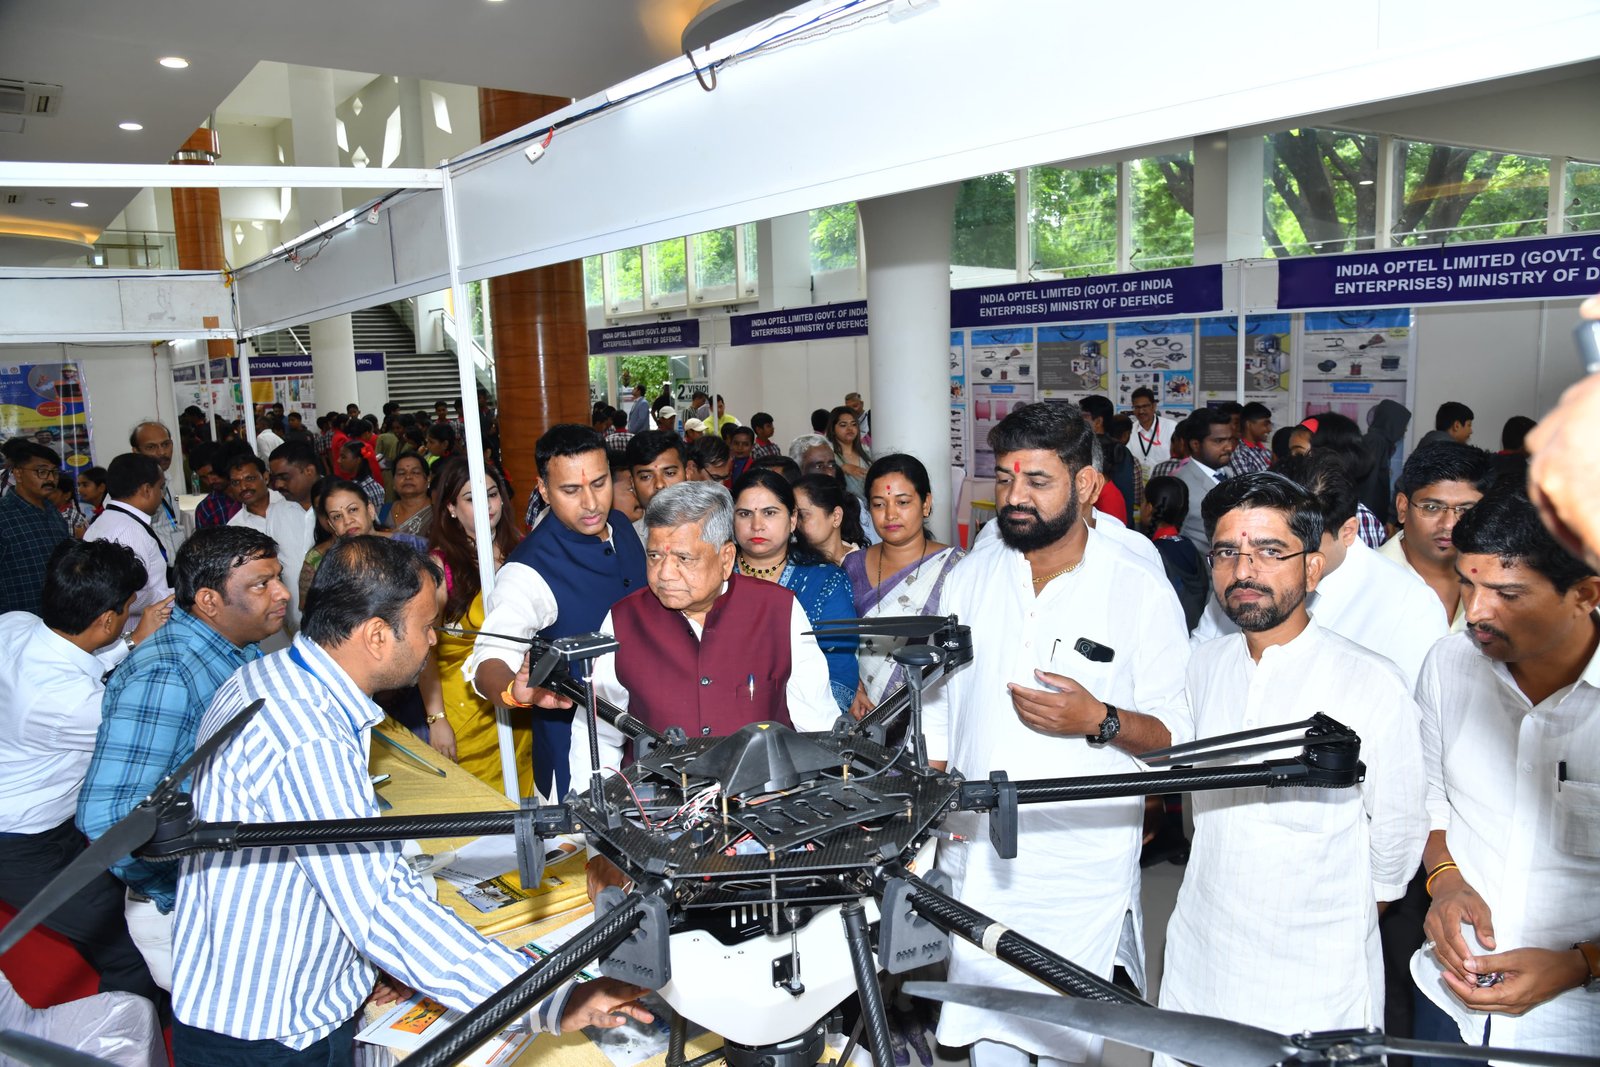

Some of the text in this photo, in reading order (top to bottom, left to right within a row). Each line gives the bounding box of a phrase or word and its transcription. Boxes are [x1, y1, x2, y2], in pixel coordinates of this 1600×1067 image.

[1336, 264, 1379, 277] INDIA
[1384, 259, 1438, 275] OPTEL
[1443, 253, 1515, 270] LIMITED
[1521, 248, 1586, 268] (GOVT.
[1335, 276, 1453, 294] ENTERPRISES)
[1458, 270, 1547, 288] MINISTRY
[1553, 268, 1580, 283] OF
[980, 278, 1173, 304] INDIA OPTEL LIMITED (GOVT. OF INDIA
[980, 293, 1174, 317] ENTERPRISES) MINISTRY OF DEFENCE
[751, 307, 868, 327] INDIA OPTEL LIMITED (GOVT. OF INDIA
[603, 332, 614, 340] INDIA
[614, 331, 627, 339] OPTEL
[628, 330, 645, 338] LIMITED
[751, 319, 869, 338] ENTERPRISES) MINISTRY OF DEFENCE
[632, 337, 652, 346] MINISTRY
[653, 336, 660, 344] OF
[660, 335, 682, 343] DEFENCE
[356, 358, 373, 366] (NIC)
[687, 384, 709, 394] VISIO
